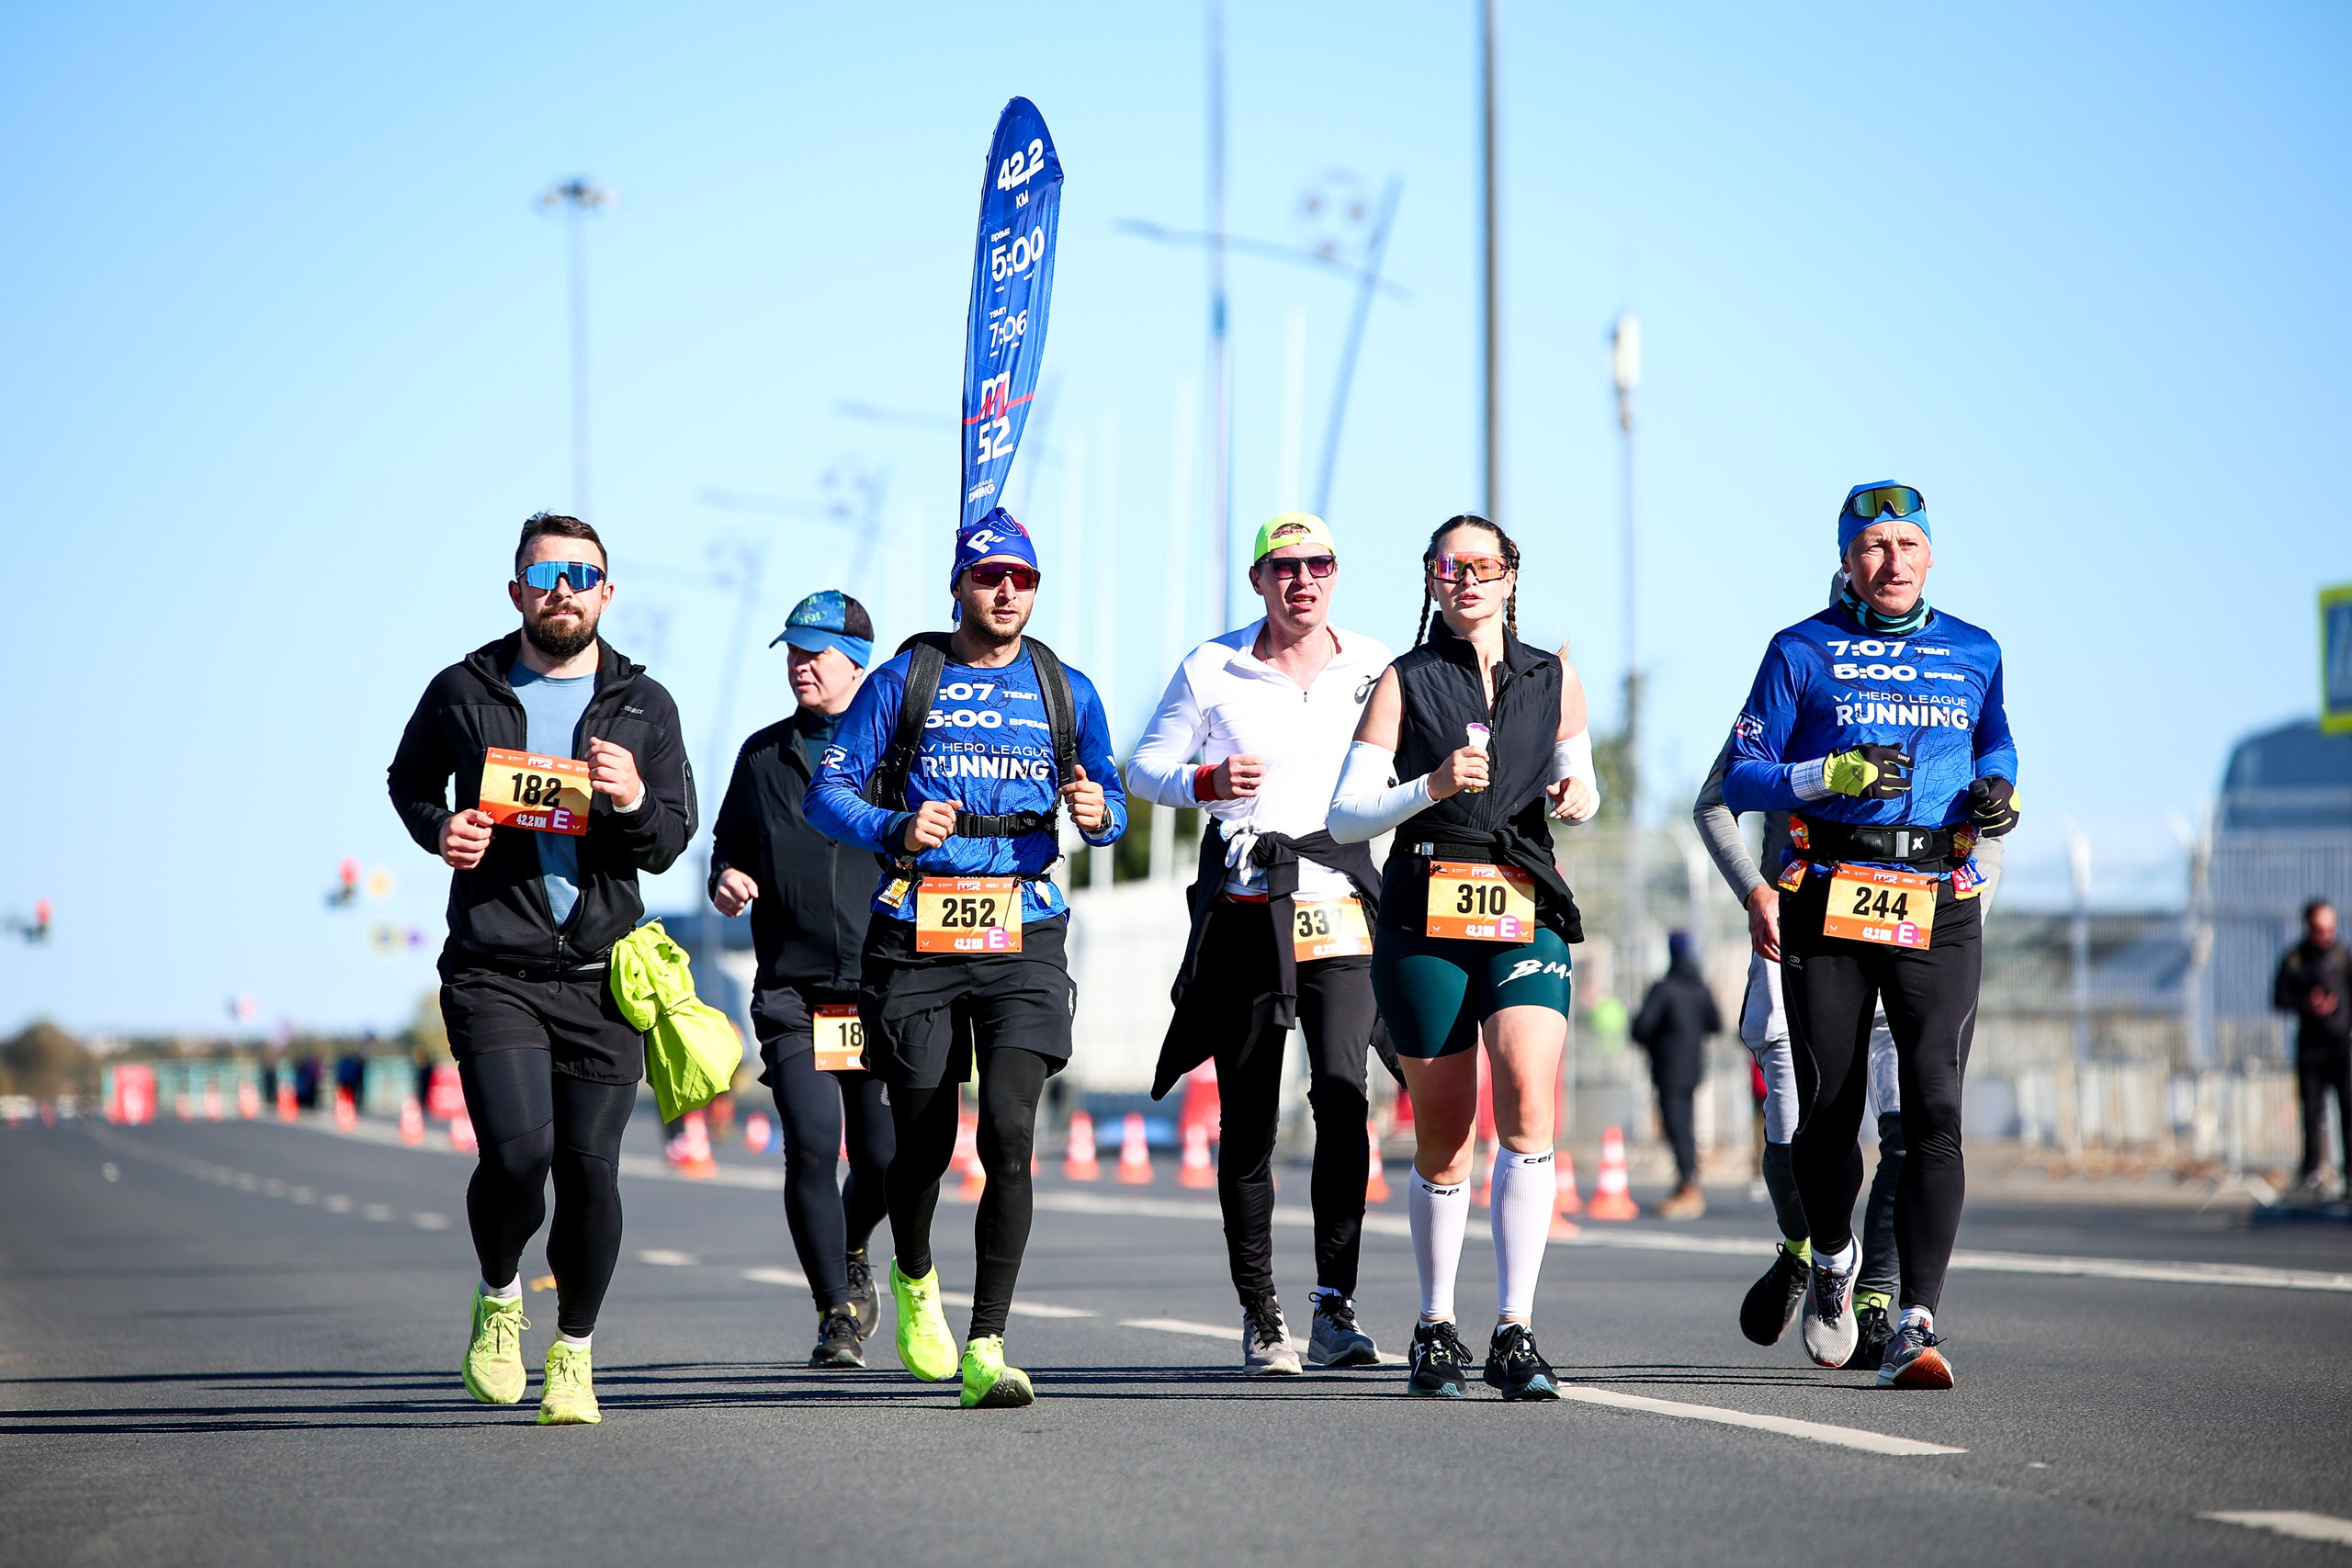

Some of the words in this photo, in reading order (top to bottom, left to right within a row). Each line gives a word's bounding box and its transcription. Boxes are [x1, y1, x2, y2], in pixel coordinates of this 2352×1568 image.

[997, 138, 1045, 192] 42,2
[991, 225, 1045, 282] 5:00
[989, 309, 1027, 349] 7:06
[977, 415, 1013, 465] 52
[1826, 639, 1906, 658] 7:07
[1833, 663, 1918, 682] 5:00
[939, 682, 996, 701] :07
[1859, 691, 1904, 703] HERO
[1909, 694, 1968, 708] LEAGUE
[924, 709, 1002, 728] 5:00
[1836, 702, 1969, 730] RUNNING
[942, 742, 986, 753] HERO
[991, 744, 1049, 758] LEAGUE
[921, 755, 1050, 781] RUNNING
[512, 773, 561, 807] 182
[516, 813, 534, 828] 42,2
[553, 809, 571, 829] E
[1456, 884, 1507, 915] 310
[1852, 886, 1908, 920] 244
[942, 897, 996, 928] 252
[989, 928, 1005, 949] E
[1500, 918, 1517, 938] E
[1898, 924, 1915, 944] E
[838, 1022, 864, 1047] 18
